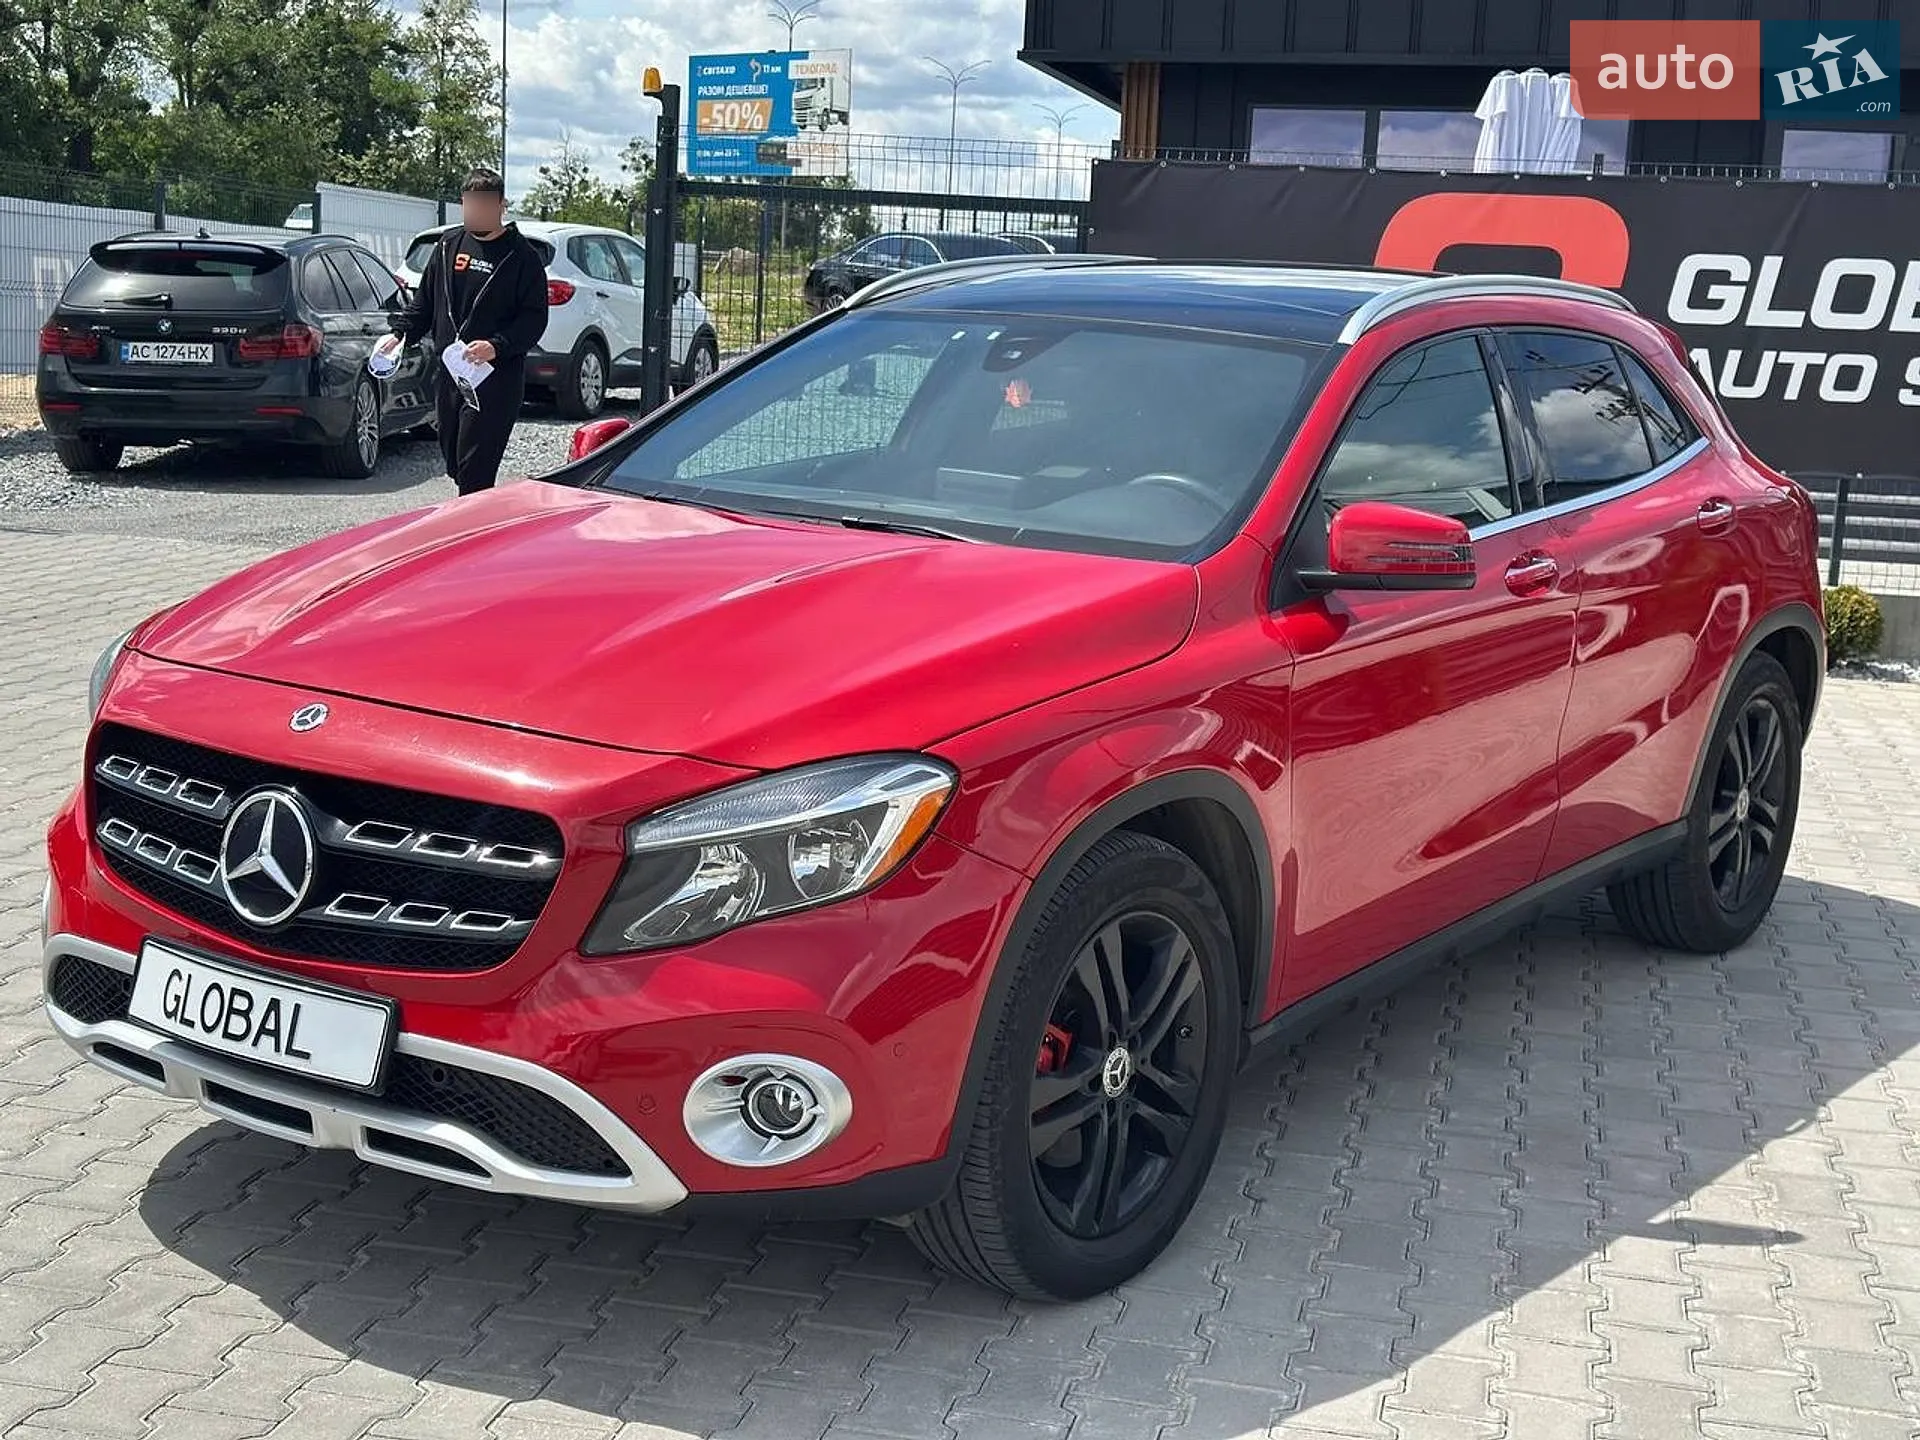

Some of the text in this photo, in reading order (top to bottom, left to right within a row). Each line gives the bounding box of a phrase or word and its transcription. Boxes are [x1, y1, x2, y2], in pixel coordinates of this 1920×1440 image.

[701, 101, 764, 131] -50%
[130, 344, 209, 360] AC 1274 HX
[163, 968, 312, 1060] GLOBAL
